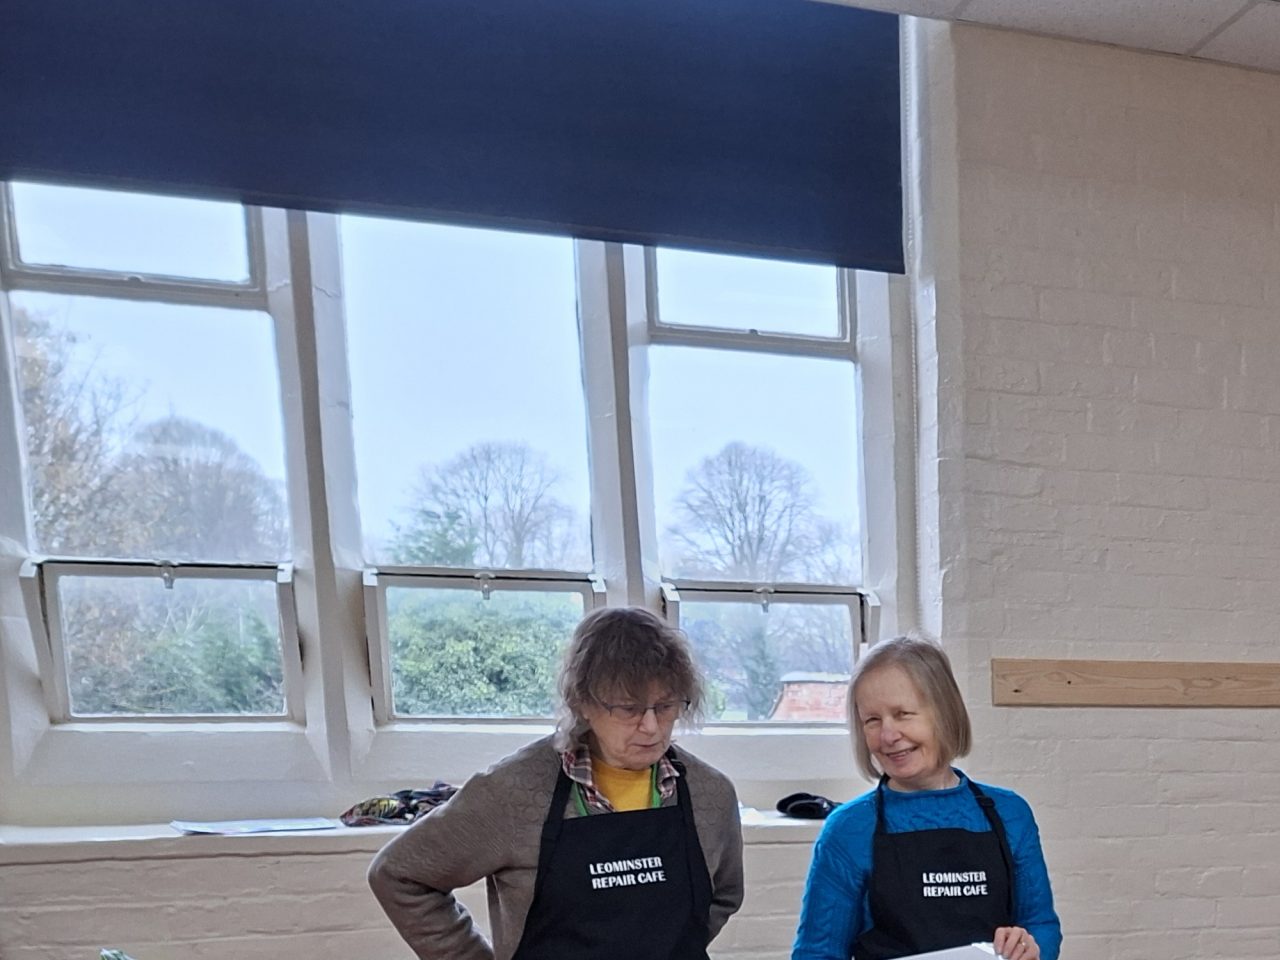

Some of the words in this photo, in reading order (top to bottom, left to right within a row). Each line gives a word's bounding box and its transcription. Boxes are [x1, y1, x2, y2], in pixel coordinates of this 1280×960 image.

[589, 856, 663, 875] LEOMINSTER
[591, 873, 637, 889] REPAIR
[637, 870, 667, 884] CAFE
[922, 870, 987, 884] LEOMINSTER
[923, 885, 962, 897] REPAIR
[962, 884, 988, 897] CAFE
